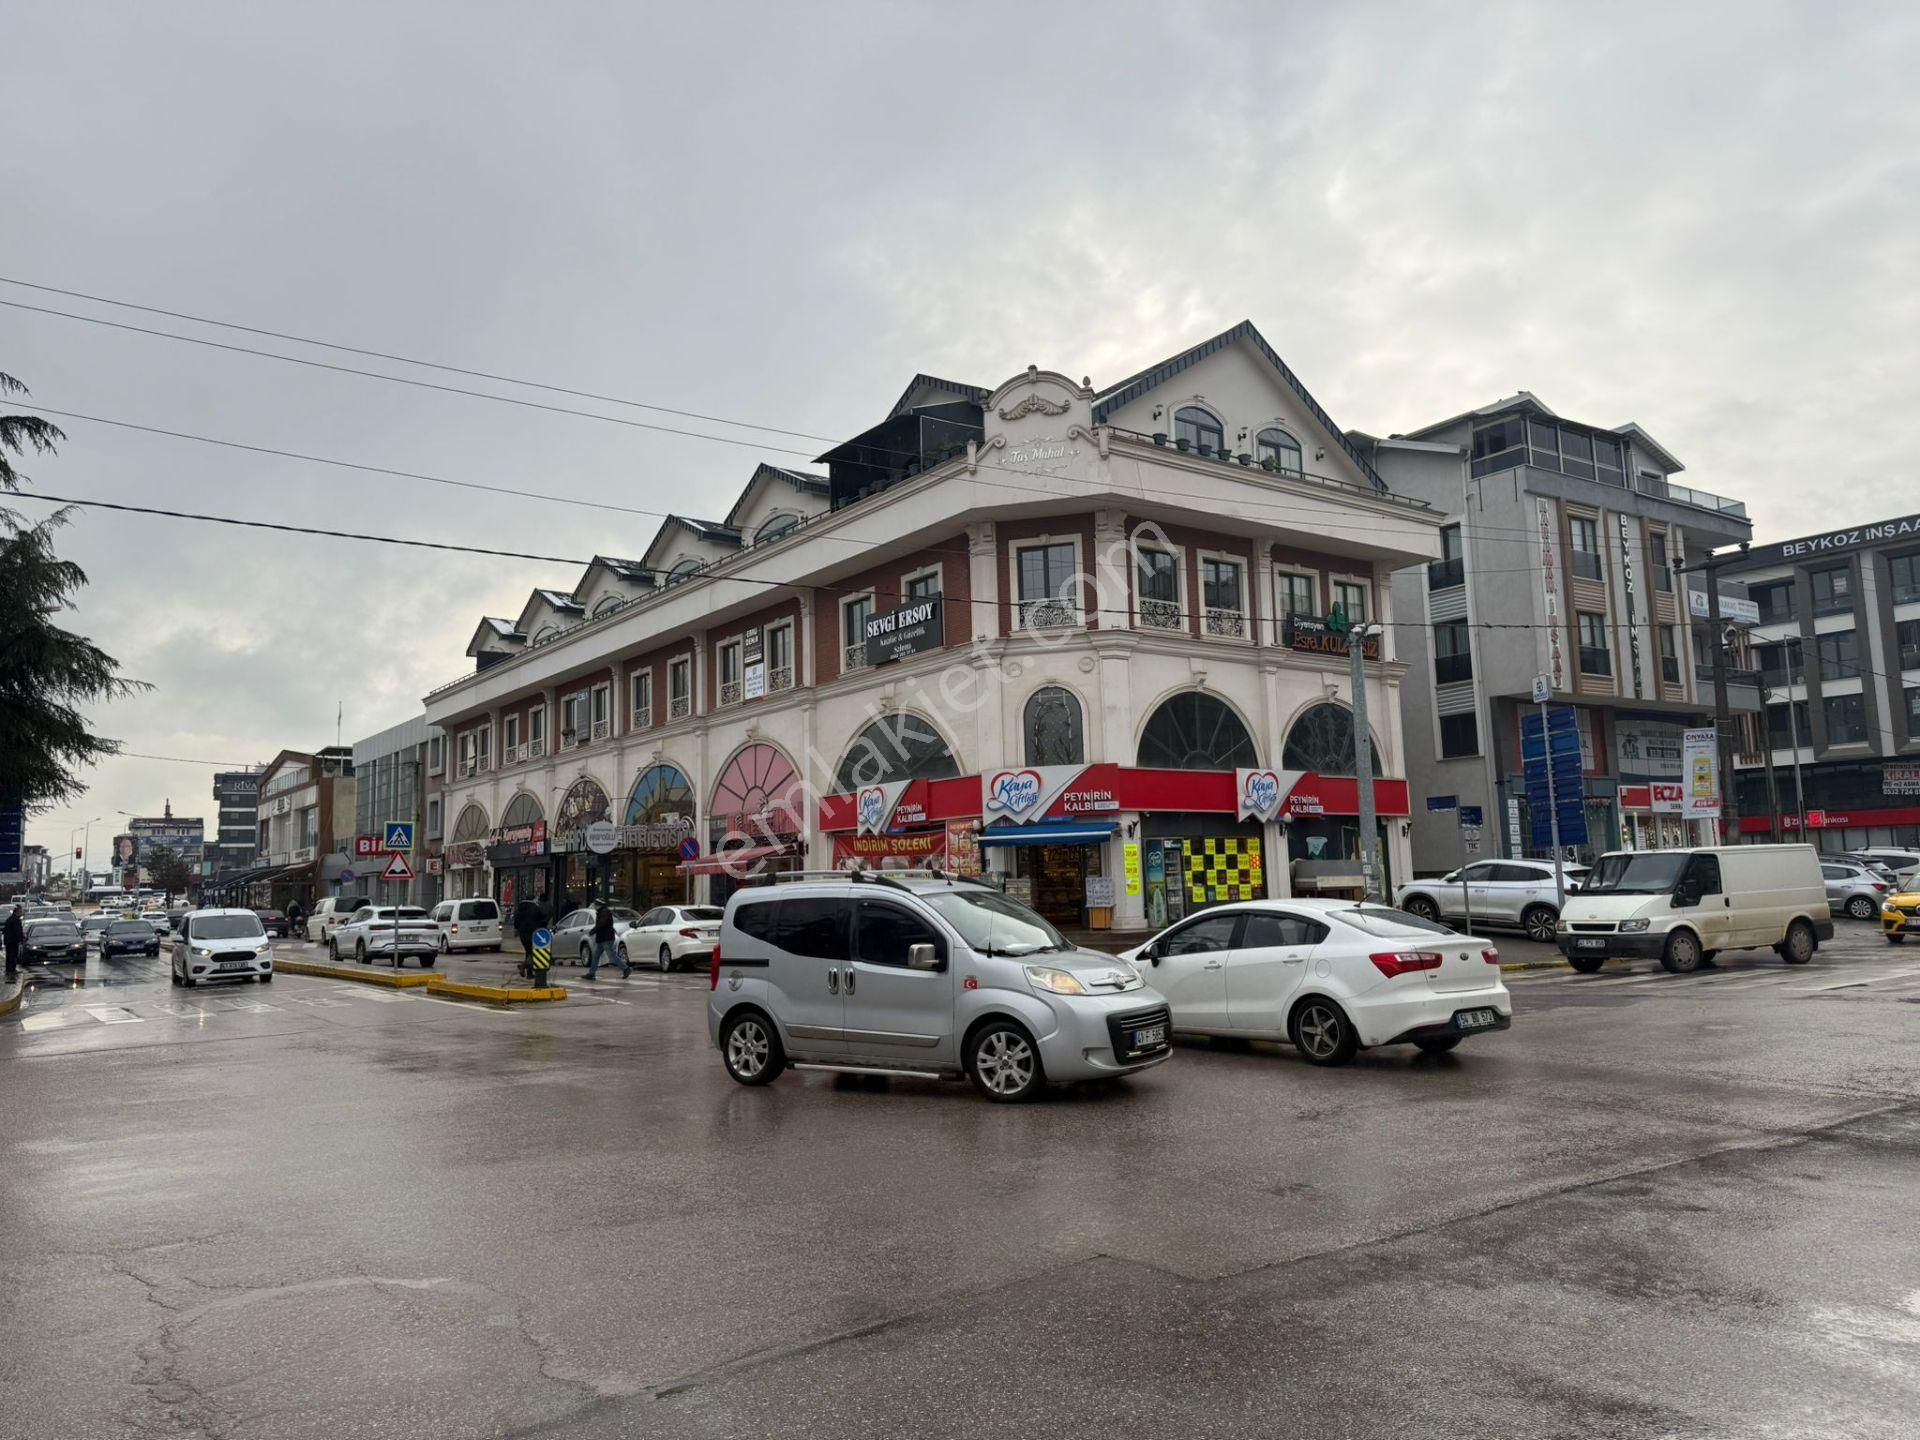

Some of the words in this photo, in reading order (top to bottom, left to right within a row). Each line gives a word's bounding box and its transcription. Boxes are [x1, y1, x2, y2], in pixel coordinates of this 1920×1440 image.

[1620, 514, 1634, 593] BEYKOZ
[1783, 531, 1861, 557] BEYKOZ
[867, 609, 896, 638] SEVGİ
[898, 602, 933, 628] ERSOY
[1064, 788, 1111, 802] PEYNİRİN
